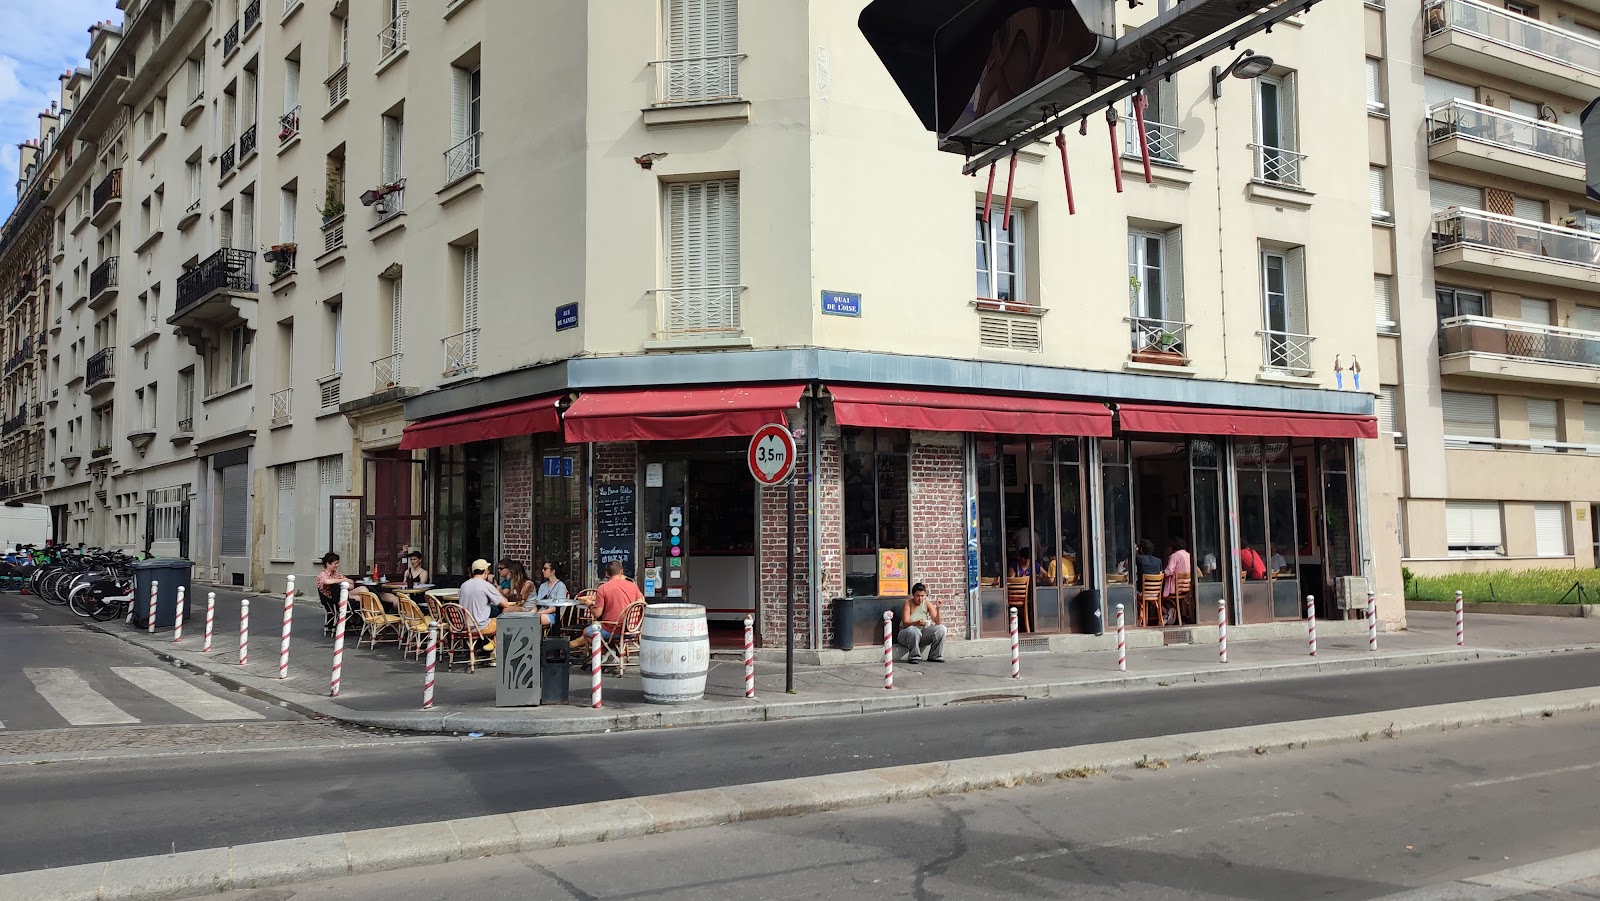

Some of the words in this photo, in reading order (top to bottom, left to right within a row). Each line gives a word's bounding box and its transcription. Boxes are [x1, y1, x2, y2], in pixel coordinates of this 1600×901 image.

[833, 296, 850, 304] QUAI
[827, 303, 836, 311] DE
[838, 304, 857, 312] L'OISE
[563, 316, 577, 325] NANTES
